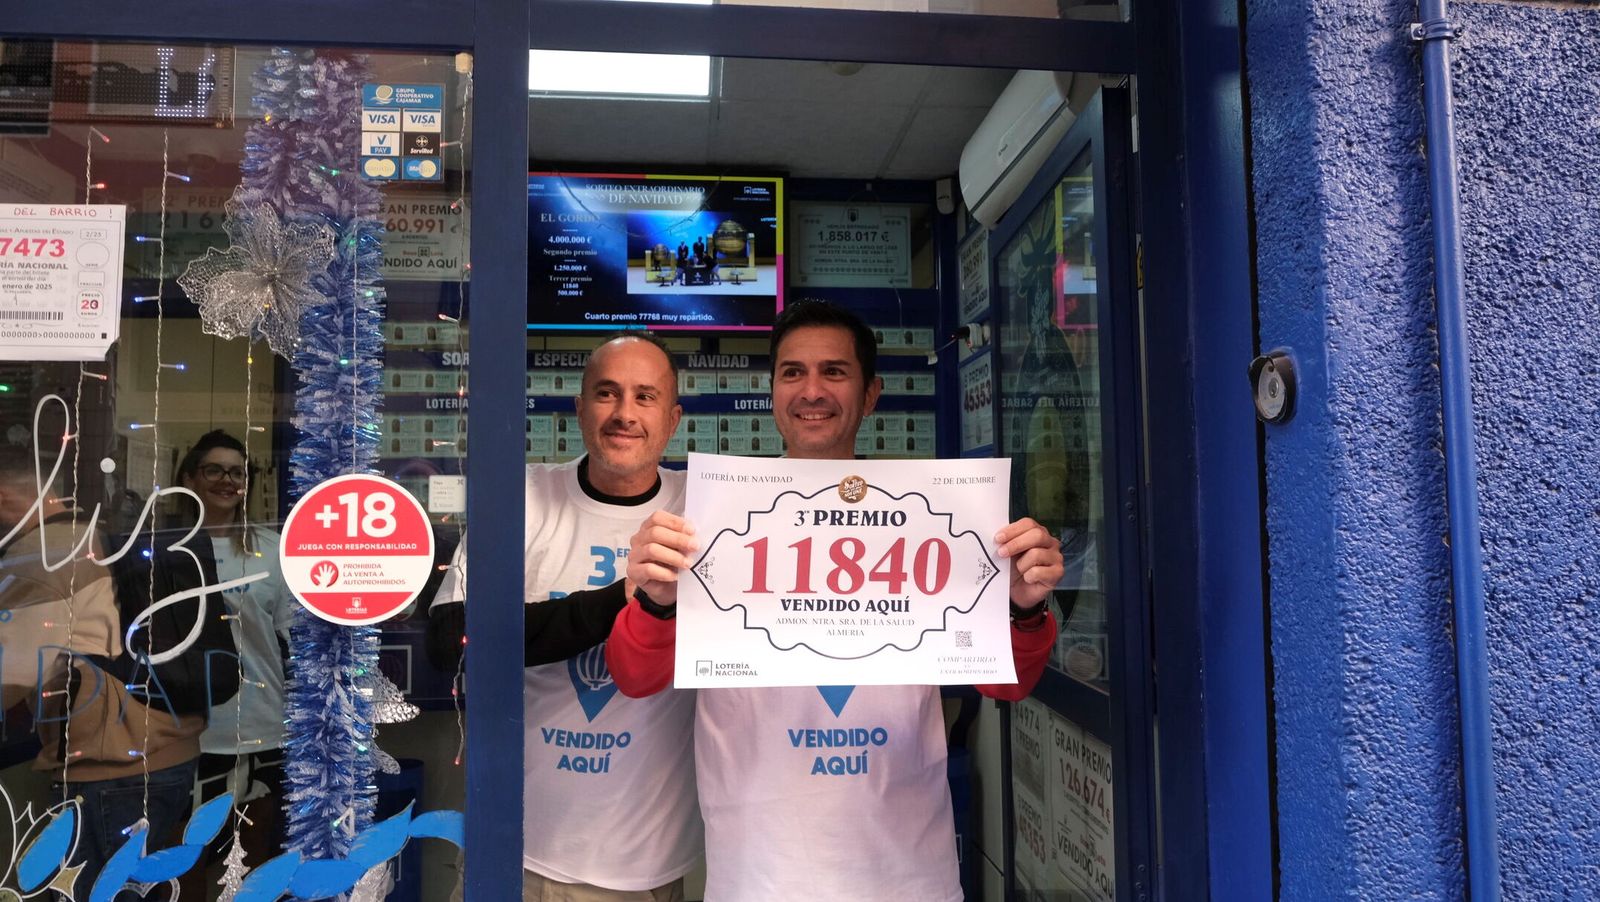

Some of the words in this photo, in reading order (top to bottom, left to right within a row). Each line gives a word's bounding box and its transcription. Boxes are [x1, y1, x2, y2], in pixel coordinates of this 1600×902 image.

[369, 114, 396, 124] VISA
[410, 114, 435, 124] VISA
[586, 184, 620, 193] SORTEO
[622, 184, 705, 193] EXTRAORDINARIO
[609, 194, 628, 204] DE
[630, 194, 683, 205] NAVIDAD
[14, 208, 37, 216] DEL
[50, 208, 97, 217] BARRIO
[412, 204, 462, 216] PREMIO
[541, 213, 556, 223] EL
[558, 213, 599, 223] GORDO
[386, 219, 445, 233] 60.991
[548, 236, 585, 244] 4.000.000
[586, 236, 592, 244] €
[818, 231, 877, 242] 1.858.017
[0, 238, 65, 257] 7473
[544, 248, 571, 257] Segundo
[380, 258, 423, 268] NDIDO
[427, 257, 457, 269] AQUÍ
[585, 312, 608, 320] Cuarto
[610, 313, 637, 322] premio
[639, 313, 661, 321] 77768
[662, 314, 678, 322] muy
[680, 313, 715, 322] repartido.
[534, 352, 590, 367] ESPECIA
[688, 355, 750, 368] NAVIDAD
[964, 380, 992, 414] 45353
[701, 471, 735, 482] LOTERÍA
[737, 475, 750, 483] DE
[752, 475, 793, 483] NAVIDAD
[932, 477, 941, 485] 22
[944, 477, 955, 485] DE
[956, 476, 996, 485] DICIEMBRE
[315, 492, 397, 538] +18
[813, 510, 907, 527] PREMIO
[742, 536, 952, 596] 11840
[780, 598, 861, 612] VENDIDO
[865, 596, 910, 616] AQUÍ
[860, 618, 873, 626] DE
[874, 618, 886, 626] LA
[541, 727, 631, 750] VENDIDO
[788, 727, 888, 748] VENDIDO
[557, 752, 612, 774] AQUÍ
[811, 750, 868, 776] AQUÍ
[1055, 729, 1080, 761] GRAN
[1082, 747, 1112, 785] PREMIO
[1060, 757, 1105, 818] 126.674
[1106, 807, 1111, 825] €
[1057, 832, 1093, 877] VENDIDO
[1096, 867, 1115, 899] AQU
